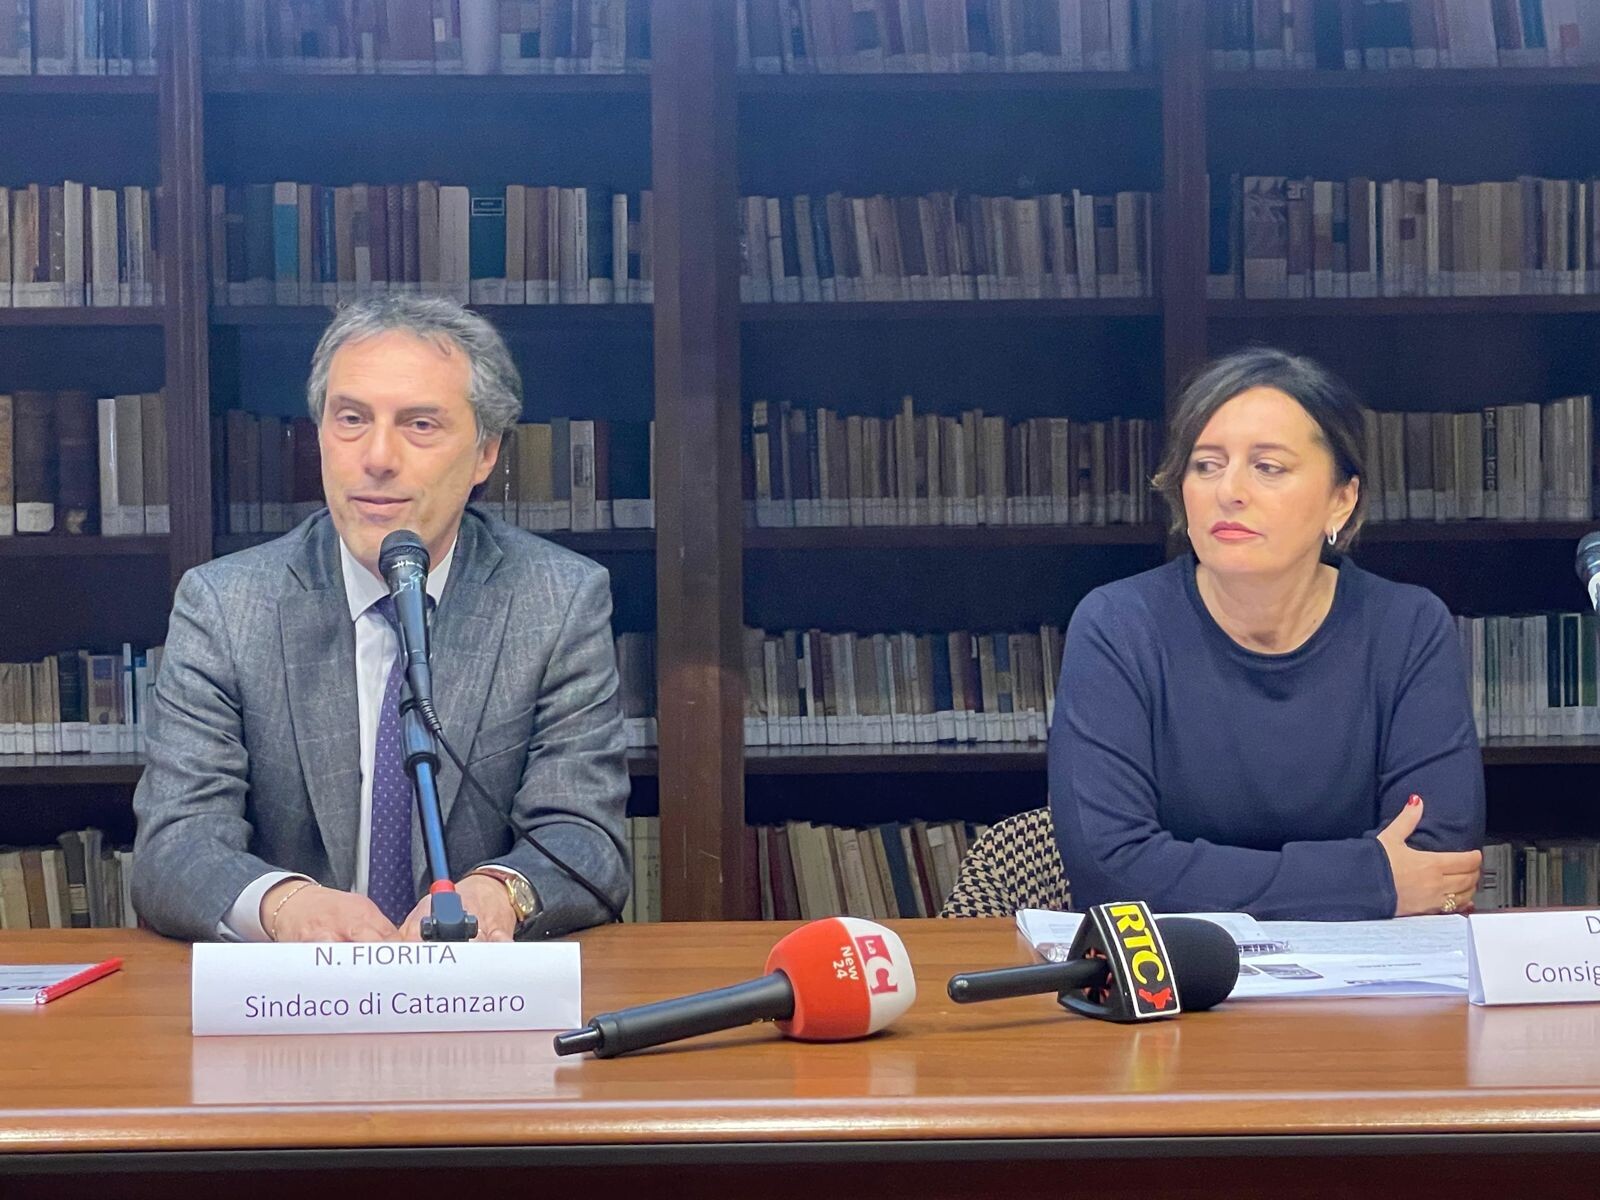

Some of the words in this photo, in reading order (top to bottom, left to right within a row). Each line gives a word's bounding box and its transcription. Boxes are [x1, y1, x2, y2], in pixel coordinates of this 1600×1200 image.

[315, 946, 342, 966] N.
[353, 944, 457, 965] FIORITA
[1109, 904, 1165, 985] RTC
[832, 960, 848, 979] 24
[841, 947, 859, 980] New
[245, 993, 350, 1018] Sindaco
[359, 992, 381, 1016] di
[391, 992, 525, 1015] Catanzaro
